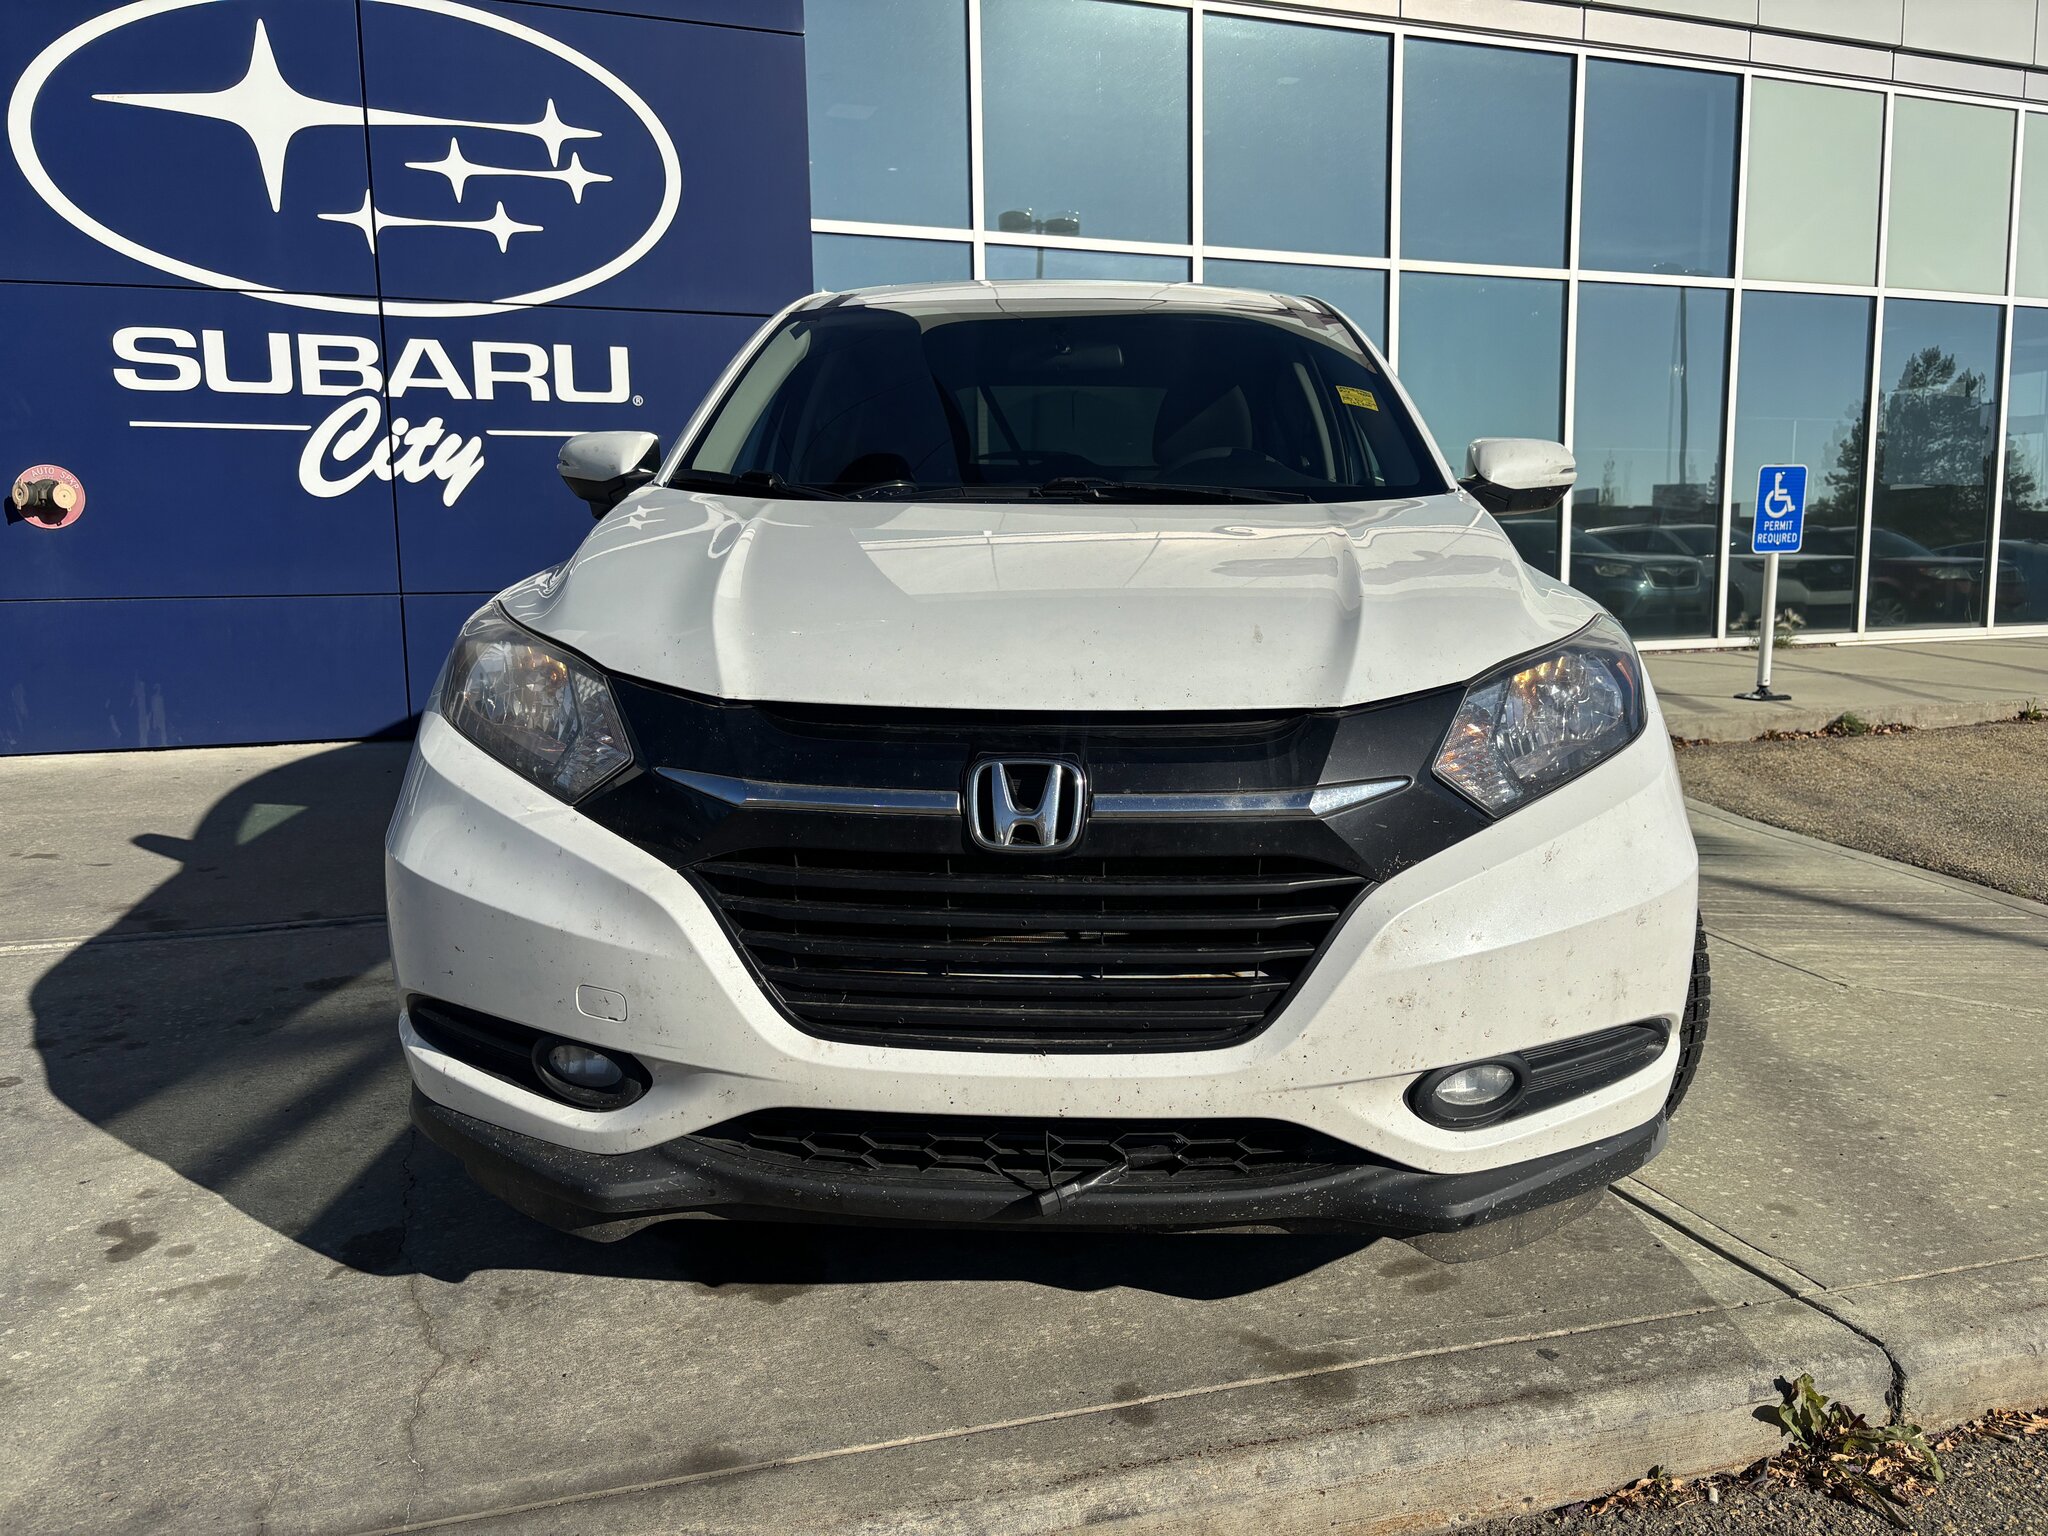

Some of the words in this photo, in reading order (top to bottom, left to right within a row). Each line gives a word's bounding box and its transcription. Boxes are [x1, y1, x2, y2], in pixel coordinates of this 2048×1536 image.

[112, 326, 630, 403] SUBARU
[299, 396, 485, 507] City
[31, 467, 55, 477] AUTO
[1763, 520, 1794, 531] PERMIT
[1757, 532, 1798, 544] REQUIRED
